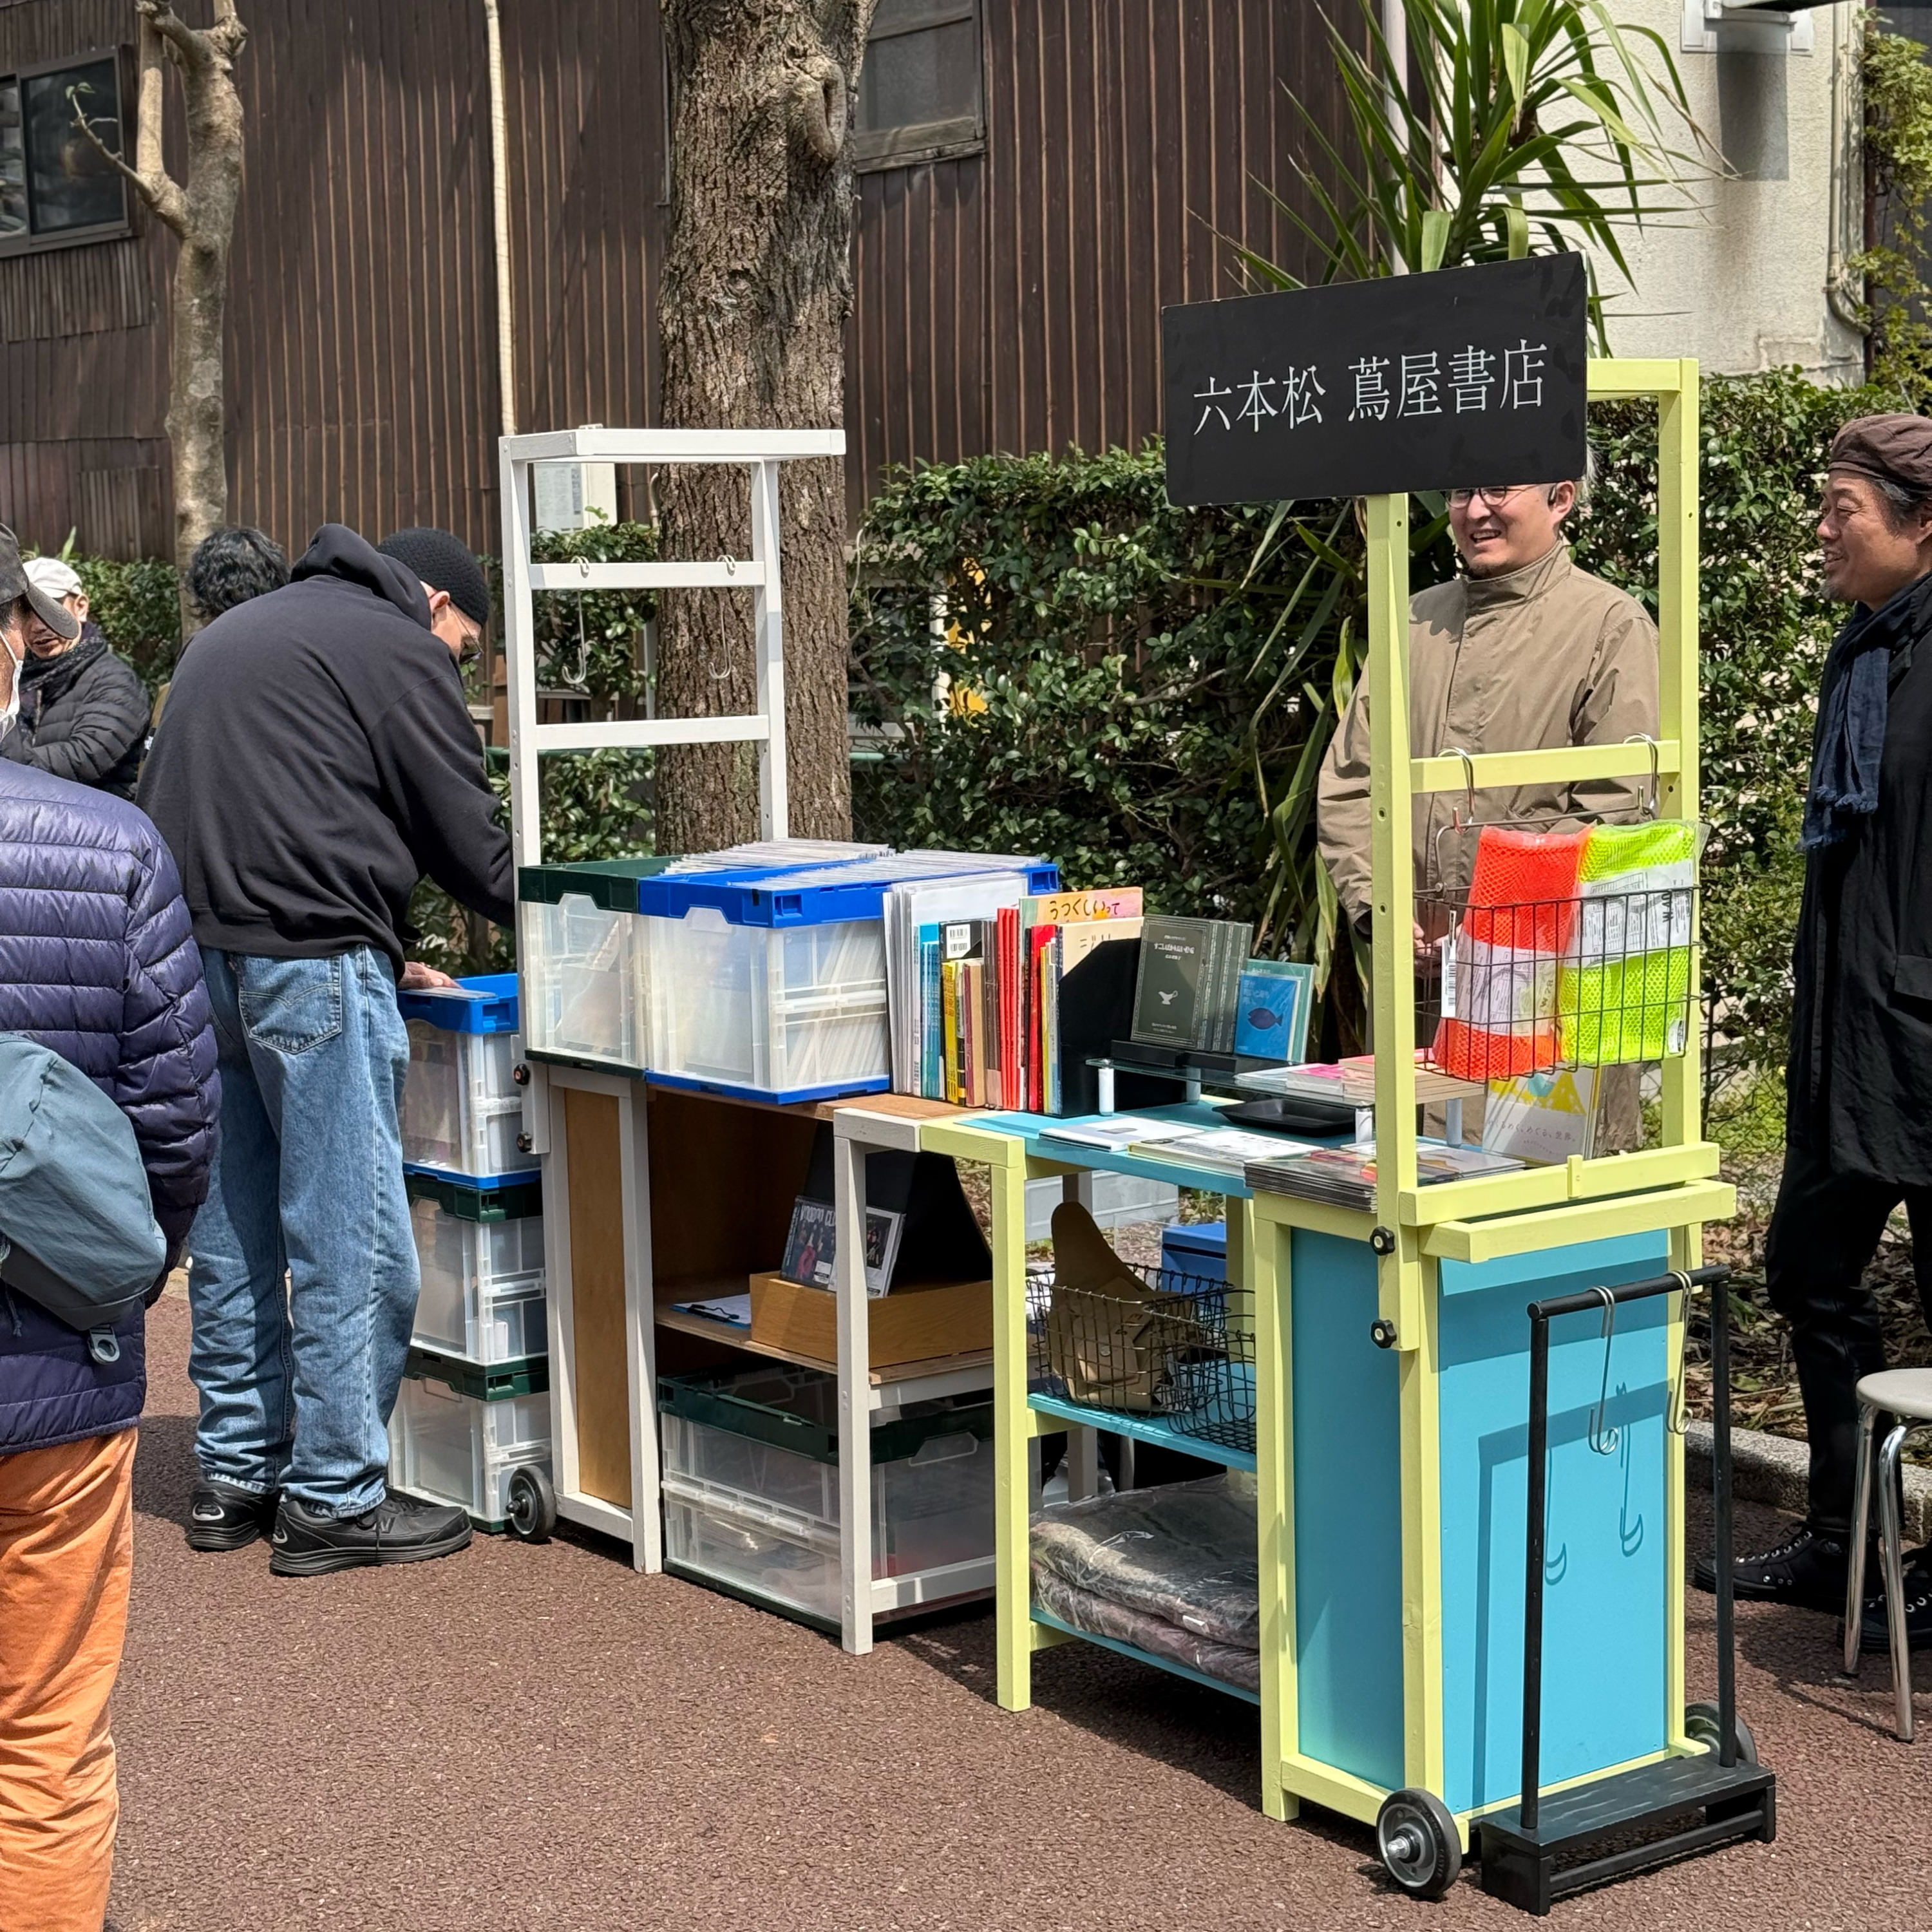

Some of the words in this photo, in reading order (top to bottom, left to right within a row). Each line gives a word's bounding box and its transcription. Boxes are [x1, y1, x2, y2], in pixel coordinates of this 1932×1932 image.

[1193, 365, 1327, 436] 六本松
[1347, 339, 1548, 422] 蔦屋書店
[1049, 898, 1121, 920] うつくしいって
